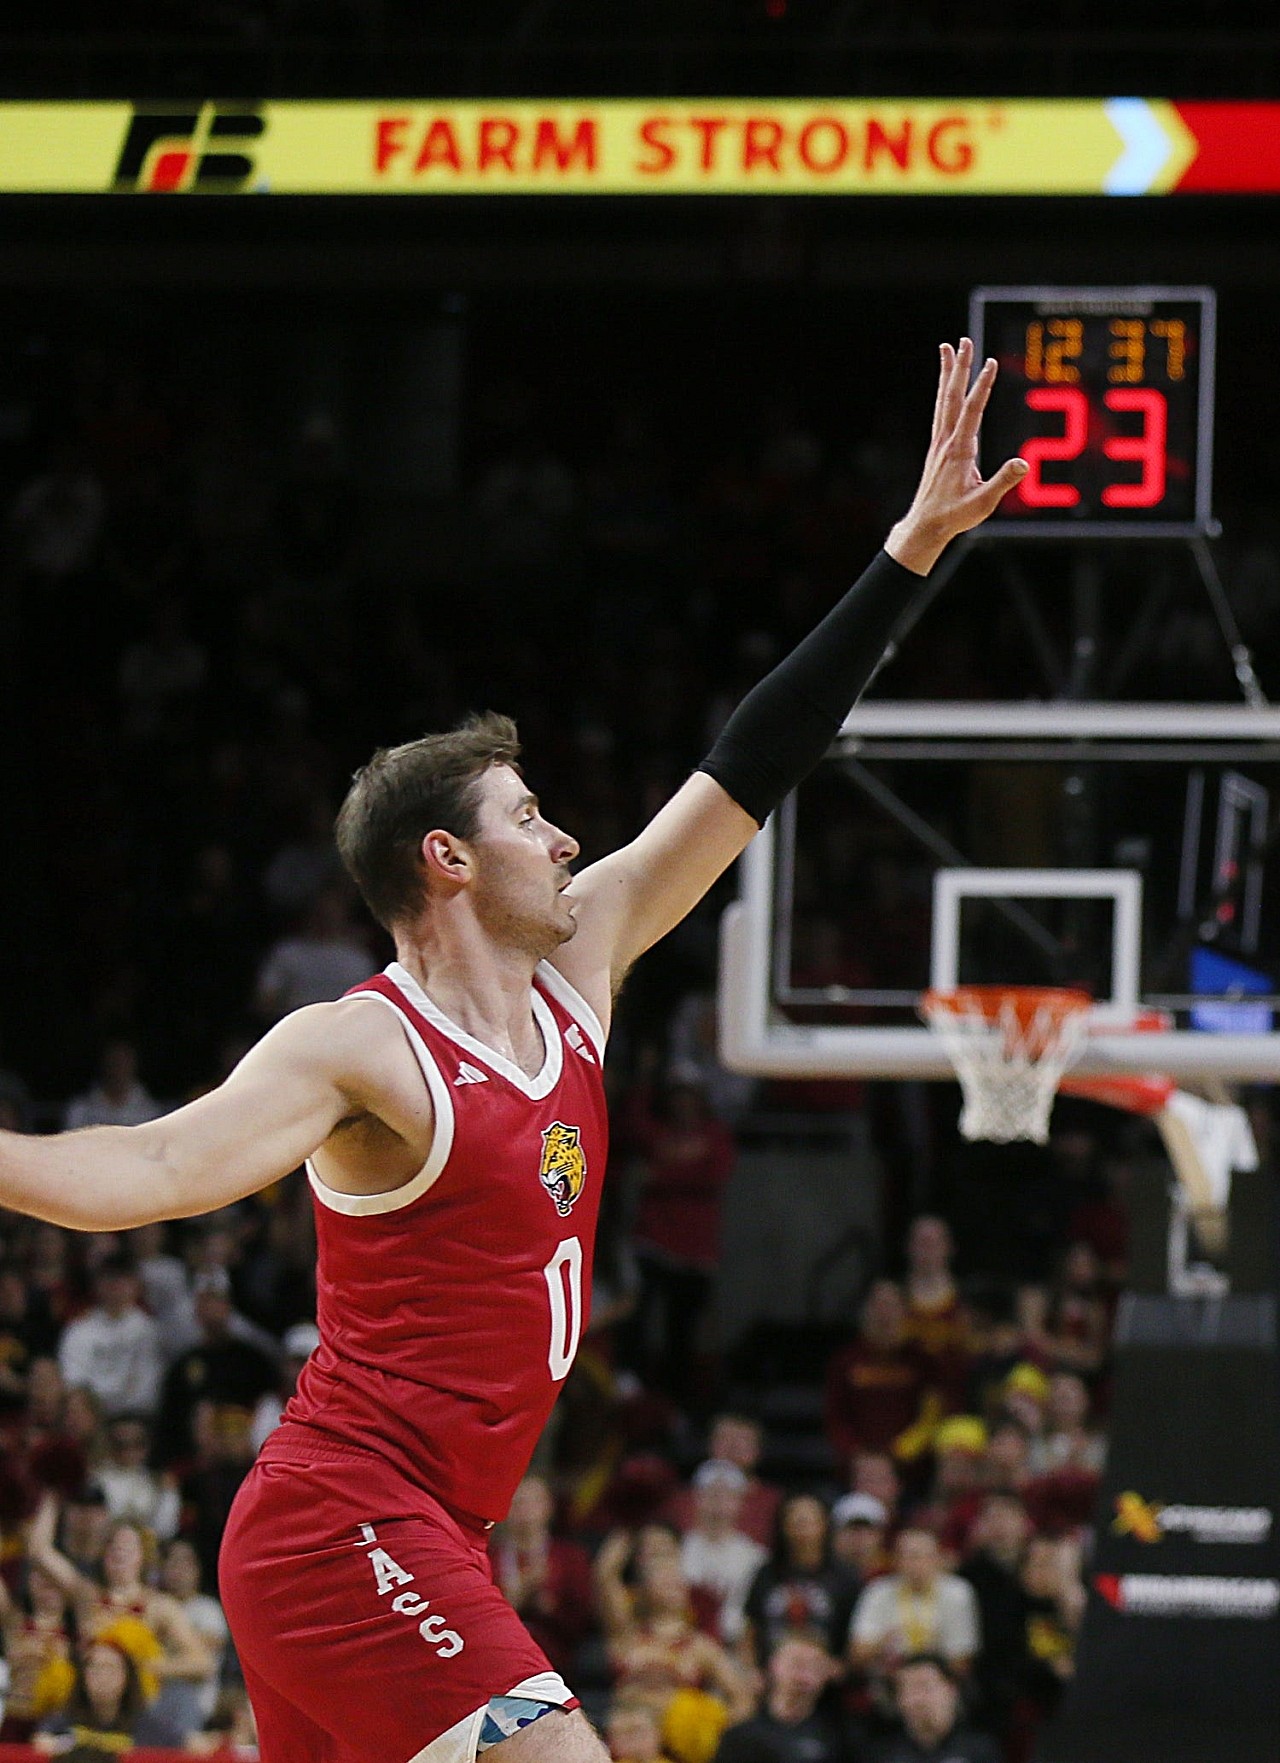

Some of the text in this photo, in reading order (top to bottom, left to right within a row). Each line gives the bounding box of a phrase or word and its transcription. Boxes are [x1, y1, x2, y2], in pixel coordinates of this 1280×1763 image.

[374, 116, 977, 176] FARM STRONG
[1025, 319, 1186, 382] 12 37
[1018, 387, 1168, 508] 23
[544, 1235, 582, 1381] 0
